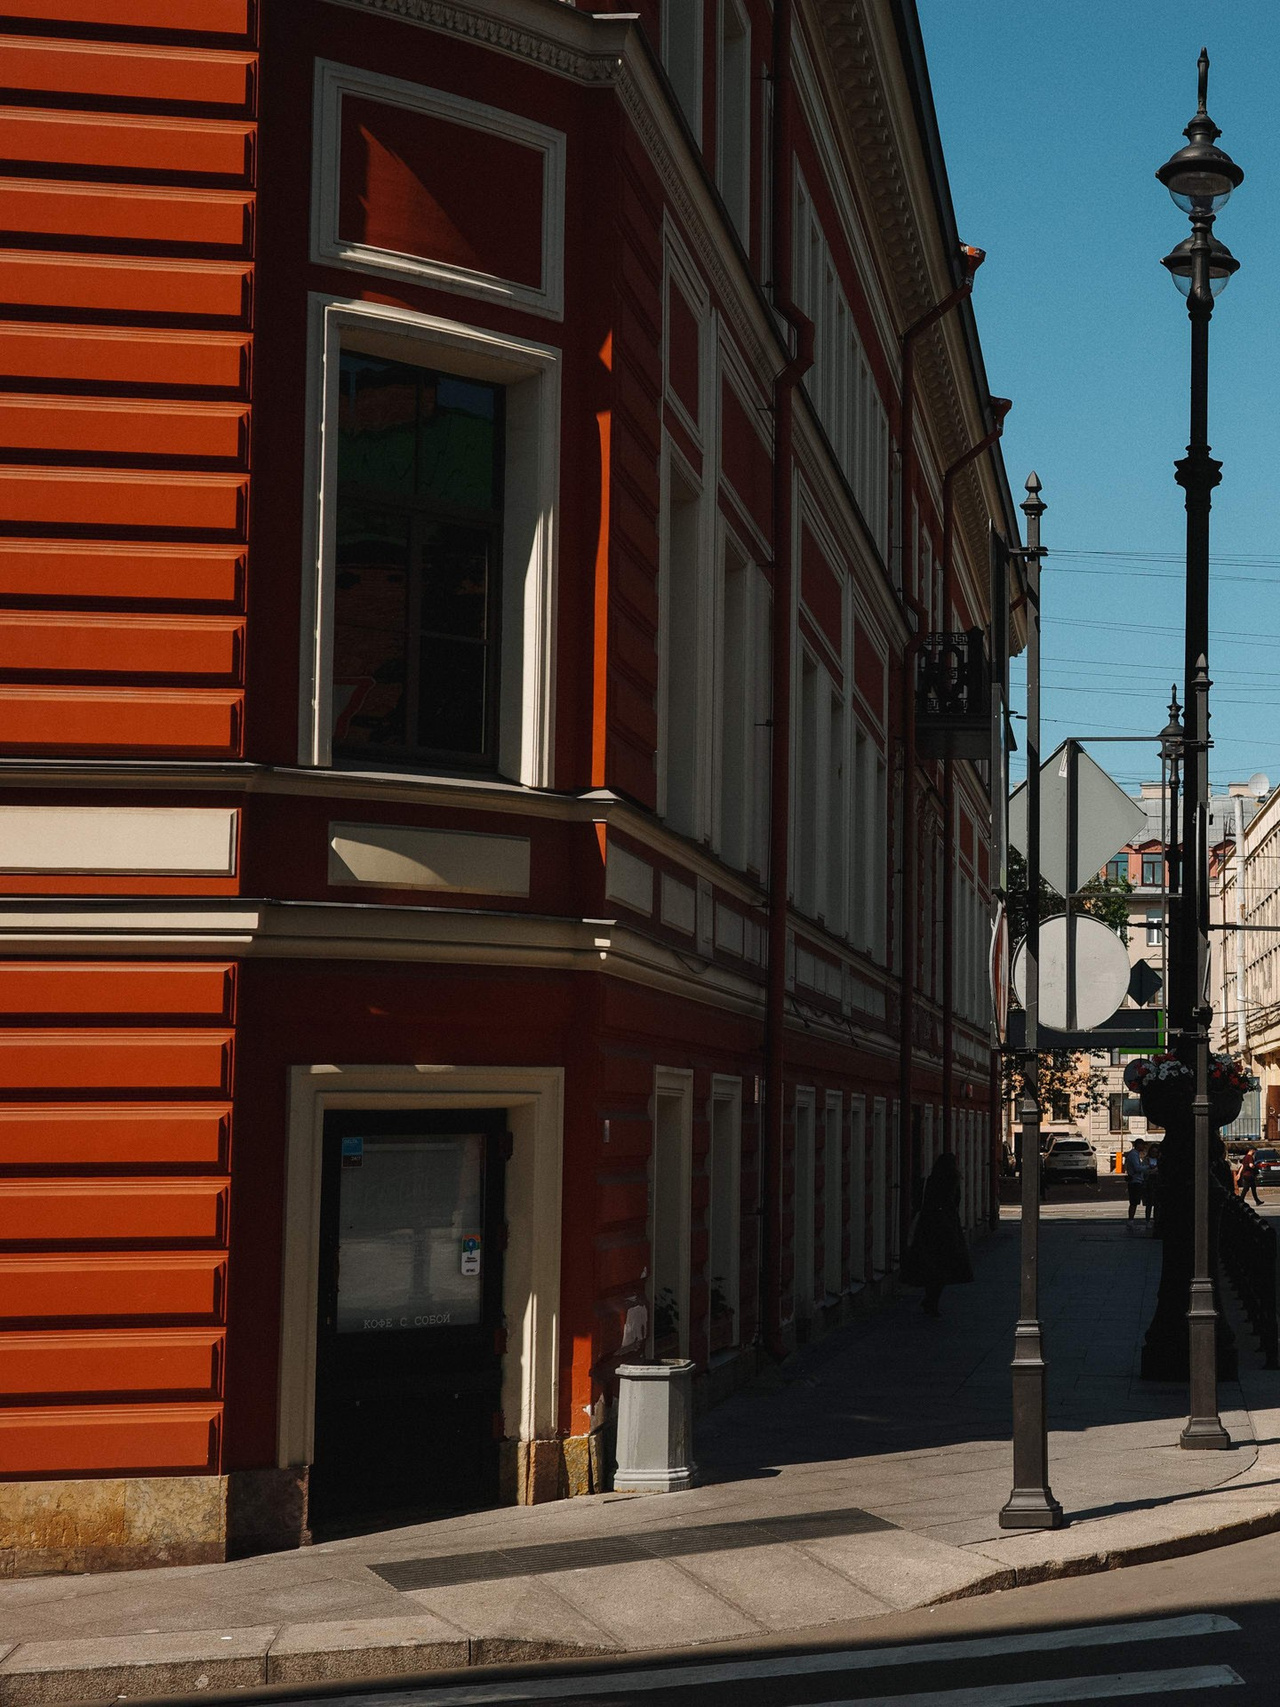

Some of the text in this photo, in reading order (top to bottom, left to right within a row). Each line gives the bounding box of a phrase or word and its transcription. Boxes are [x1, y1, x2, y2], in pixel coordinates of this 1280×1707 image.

[363, 1311, 452, 1329] КОФЕ С СОБОЙ
